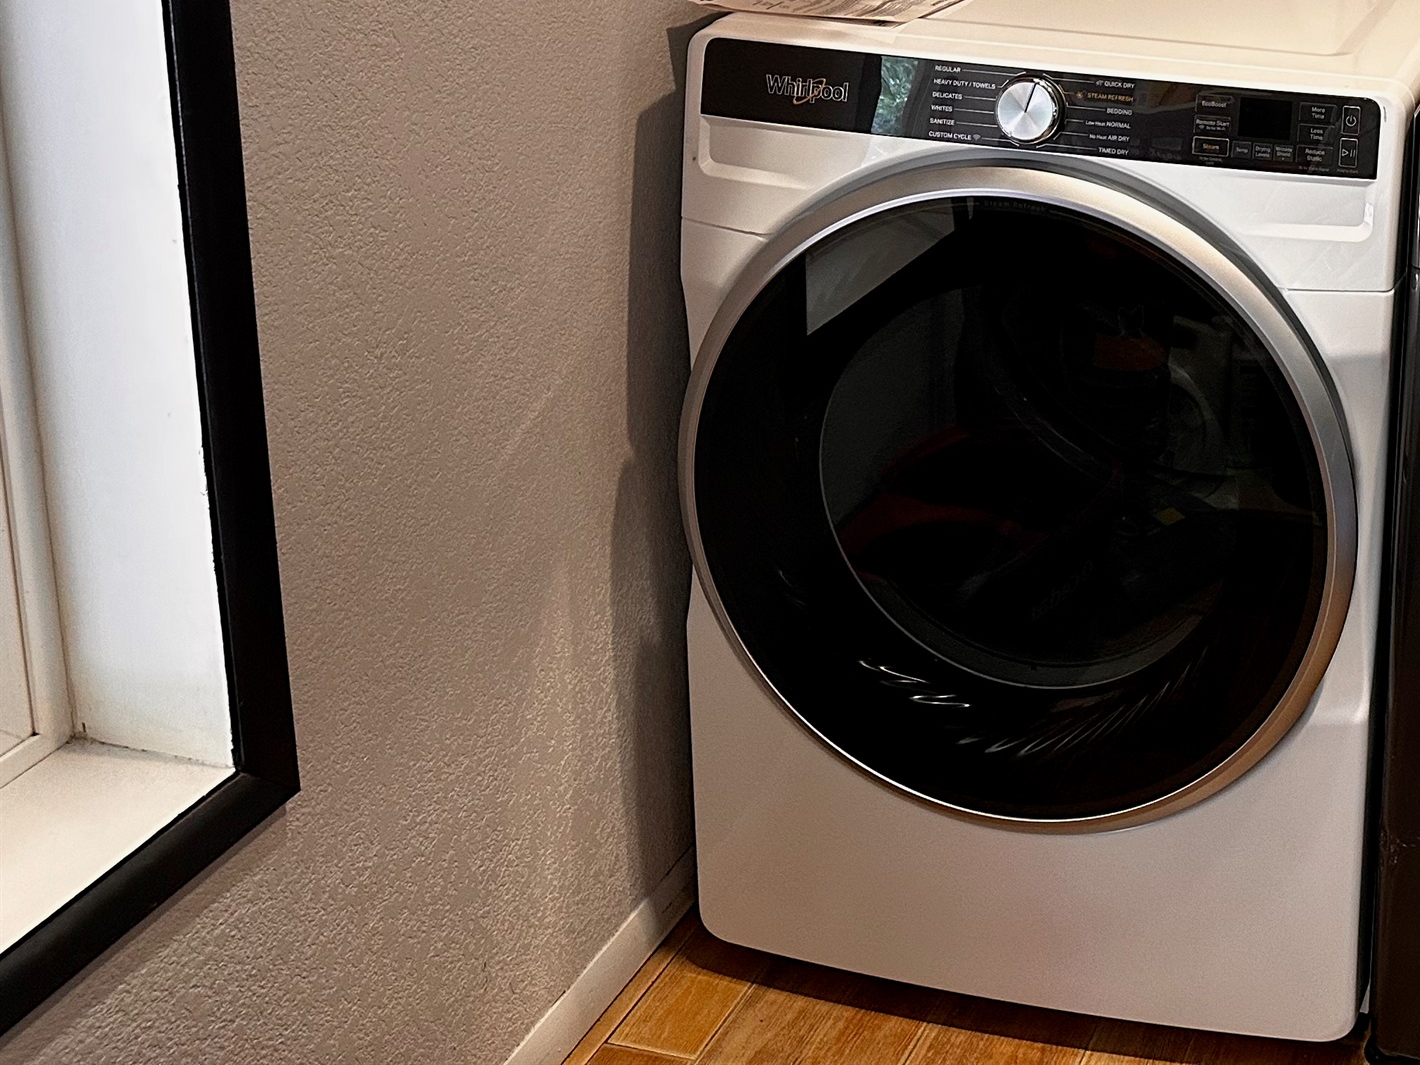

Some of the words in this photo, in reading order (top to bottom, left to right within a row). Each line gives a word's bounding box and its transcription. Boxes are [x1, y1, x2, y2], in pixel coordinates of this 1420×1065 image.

[934, 65, 961, 73] REGULAR
[933, 78, 952, 87] HEAVY
[953, 79, 968, 88] DUTY
[972, 81, 996, 90] TOWELS
[1104, 80, 1123, 88] QUICK
[1123, 81, 1135, 89] DRY
[766, 74, 849, 103] Whirlpool
[932, 91, 963, 100] DELICATES
[1087, 92, 1107, 100] STEAM
[1107, 94, 1134, 102] REFRESH
[931, 105, 953, 113] WHITES
[1106, 108, 1132, 116] BEDDING
[1311, 106, 1326, 114] More
[929, 118, 955, 126] SANITIZE
[1106, 121, 1131, 129] NORMAL
[928, 130, 953, 139] CUSTOM
[953, 132, 972, 141] CYCLE
[1118, 135, 1130, 143] DRY
[1099, 147, 1117, 155] TIMED
[1117, 148, 1129, 156] DRY
